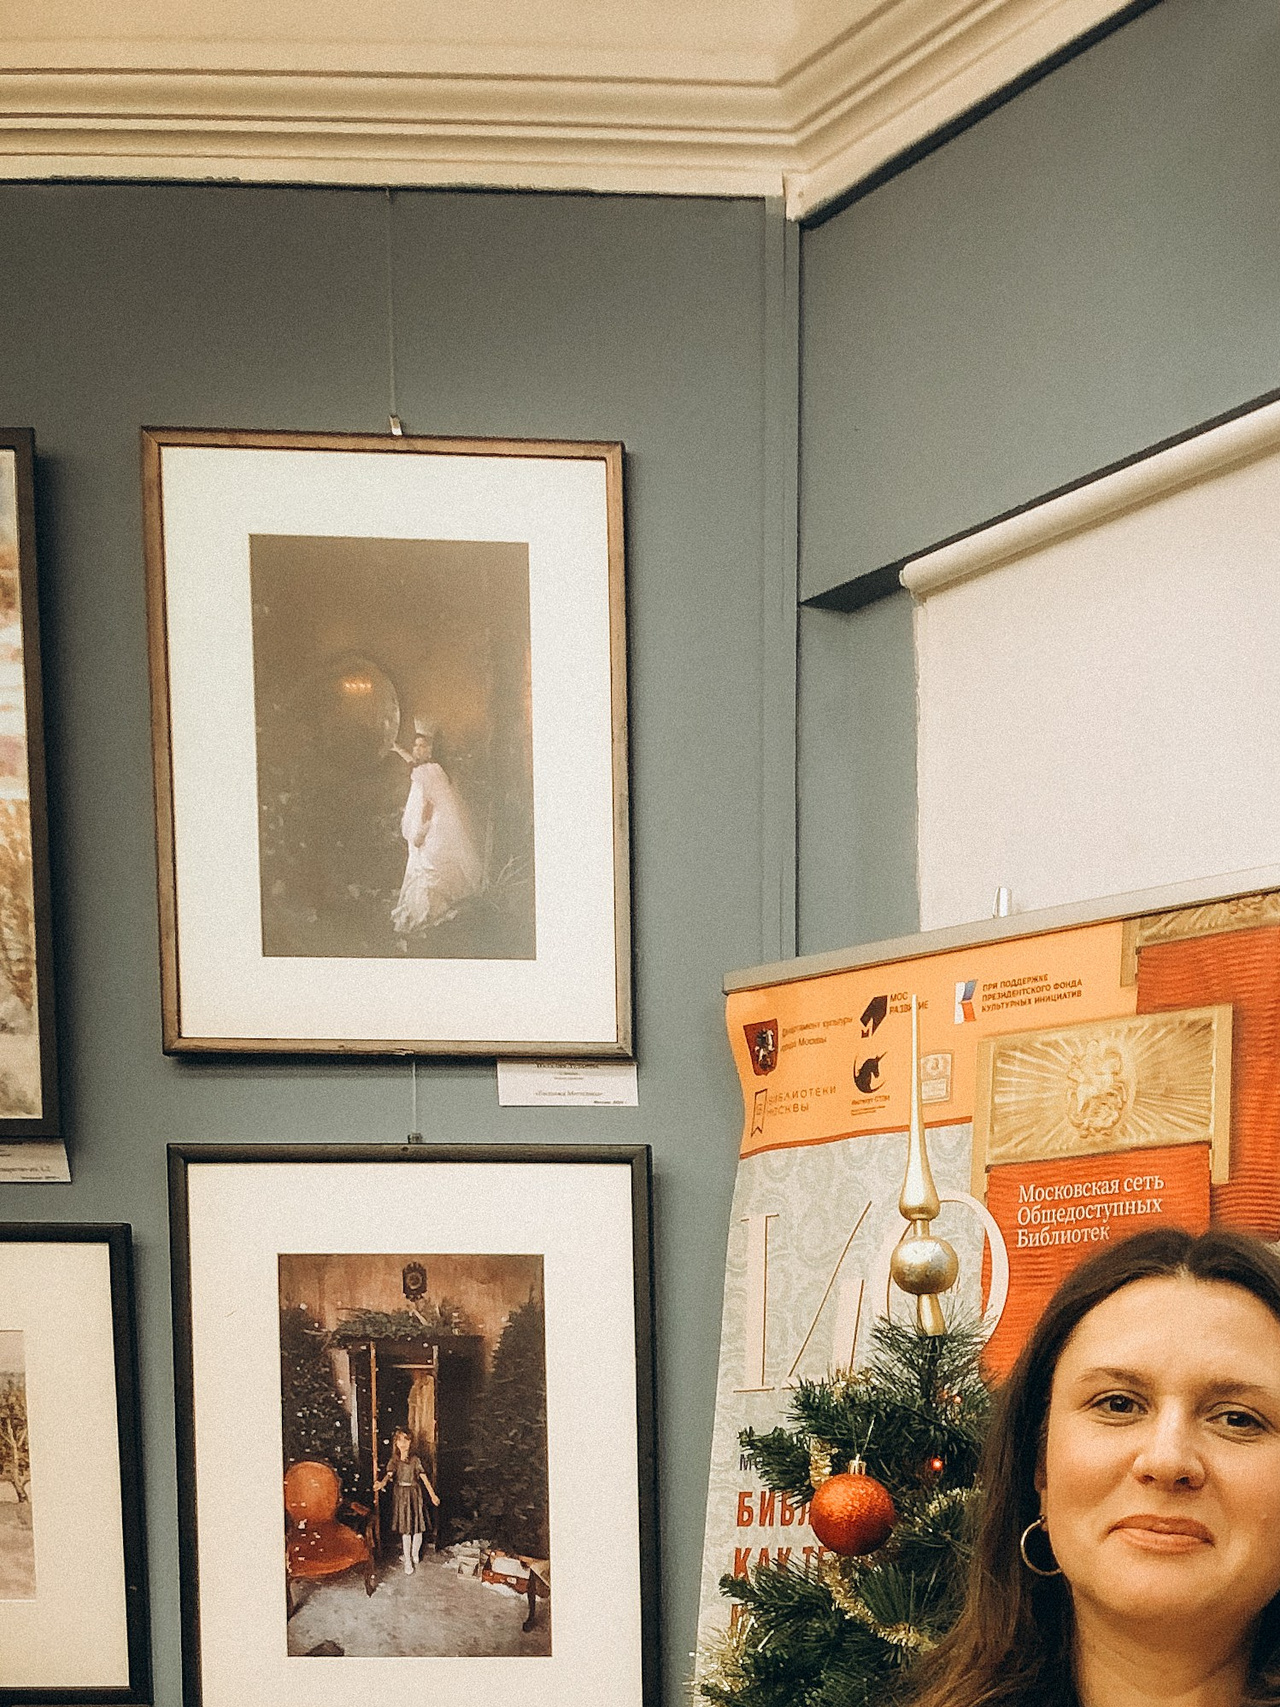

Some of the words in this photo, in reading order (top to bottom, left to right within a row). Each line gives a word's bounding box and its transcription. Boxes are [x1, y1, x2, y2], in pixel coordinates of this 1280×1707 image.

[982, 984, 1051, 1002] ПРЕЗИДЕНТСКОГО
[1053, 979, 1083, 991] ФОНДА
[983, 983, 998, 992] ПРИ
[1000, 974, 1049, 988] ПОДДЕРЖКЕ
[889, 991, 909, 1002] МОС
[889, 1000, 929, 1014] РАЗВИИЕ
[981, 998, 1032, 1012] КУЛЬТУРНЫХ
[1034, 990, 1082, 1004] ИНИЦИАТИВ
[1018, 1179, 1120, 1203] Московская
[1123, 1175, 1165, 1193] сеть
[1017, 1198, 1163, 1226] Общедоступных
[1016, 1225, 1111, 1248] Библиотек
